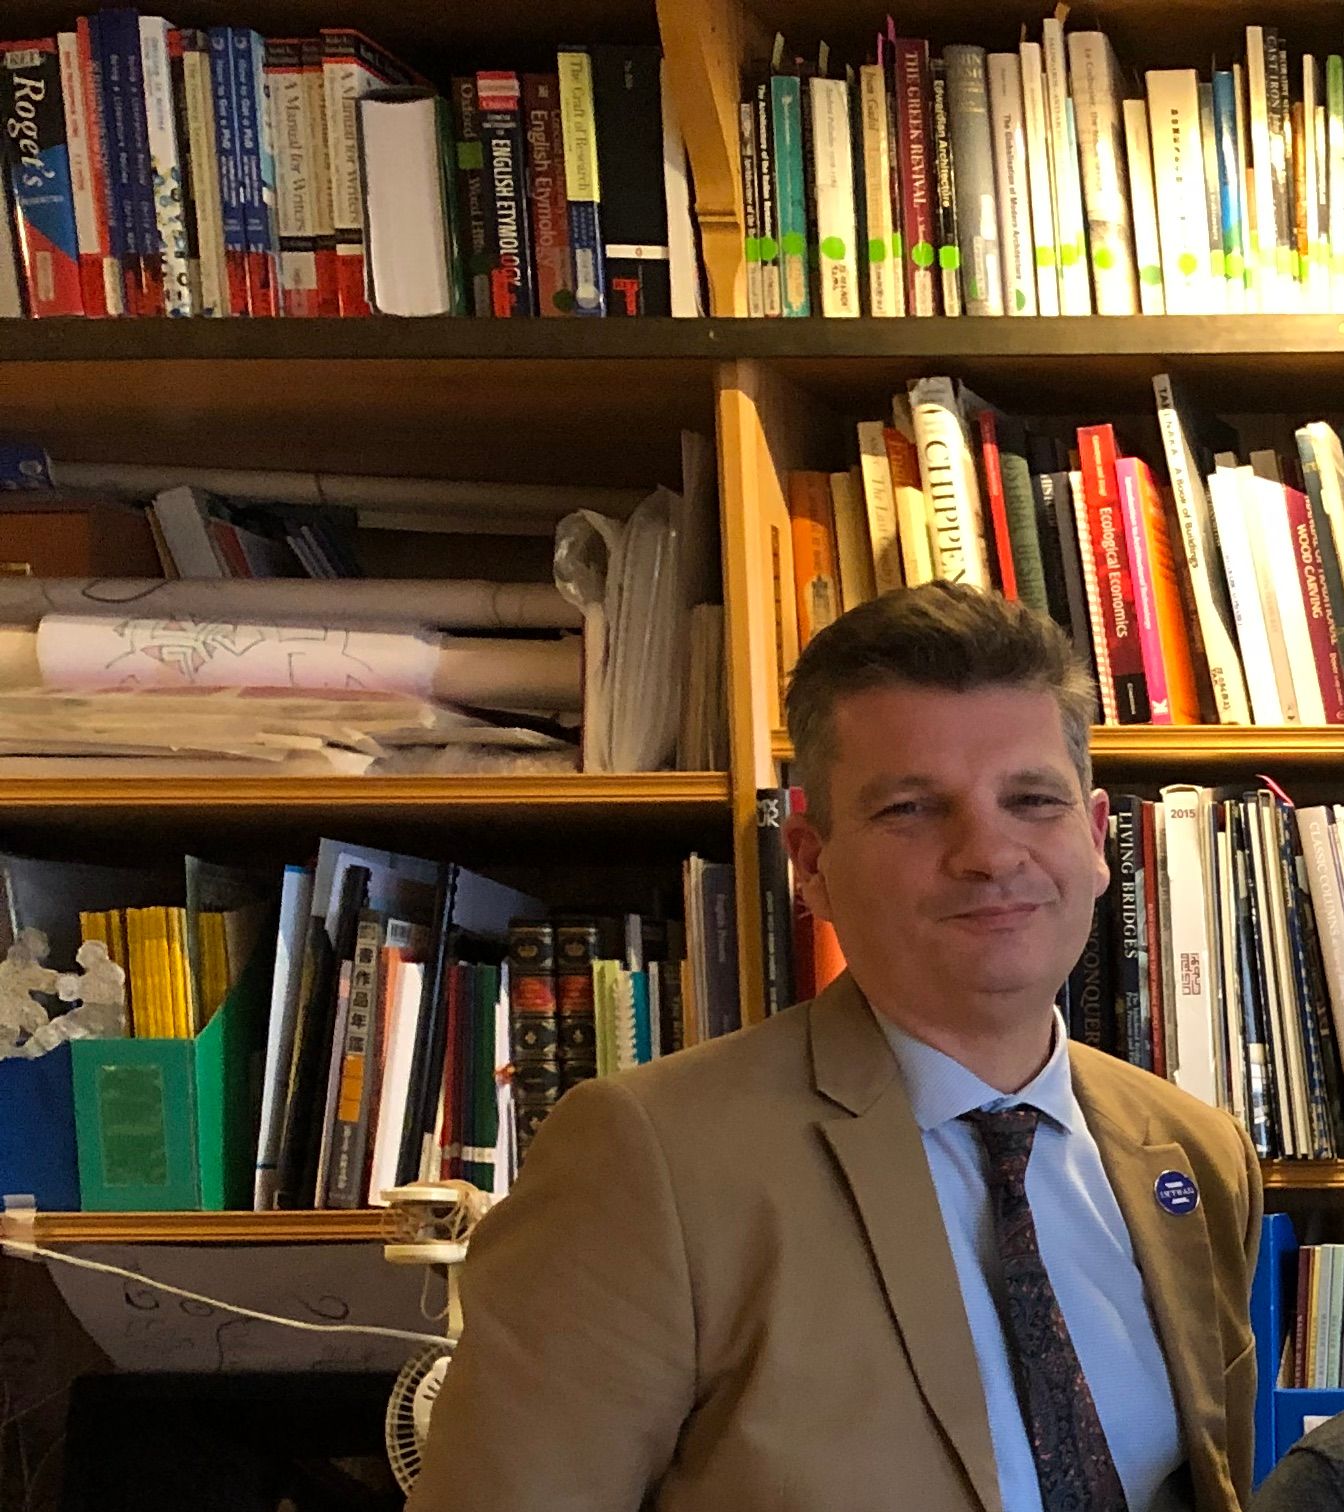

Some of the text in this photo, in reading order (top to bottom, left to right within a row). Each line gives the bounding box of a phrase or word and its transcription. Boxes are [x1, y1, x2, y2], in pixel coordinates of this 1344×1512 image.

[8, 72, 57, 188] Roget's
[286, 96, 307, 233] Manual for Writers
[491, 139, 513, 197] ENGLISH
[529, 109, 551, 172] English
[572, 87, 593, 191] Craft of Research
[904, 50, 927, 209] THE GREEK REVIVAL
[937, 139, 951, 208] Architecture
[1176, 478, 1187, 503] Book
[1184, 521, 1200, 569] Buildings
[1296, 523, 1322, 619] WOOD CARVING
[1099, 506, 1130, 639] Ecological Economics
[1170, 808, 1196, 819] 2015
[1308, 821, 1327, 872] CLASSIC
[1119, 811, 1138, 959] LIVING BRIDGES
